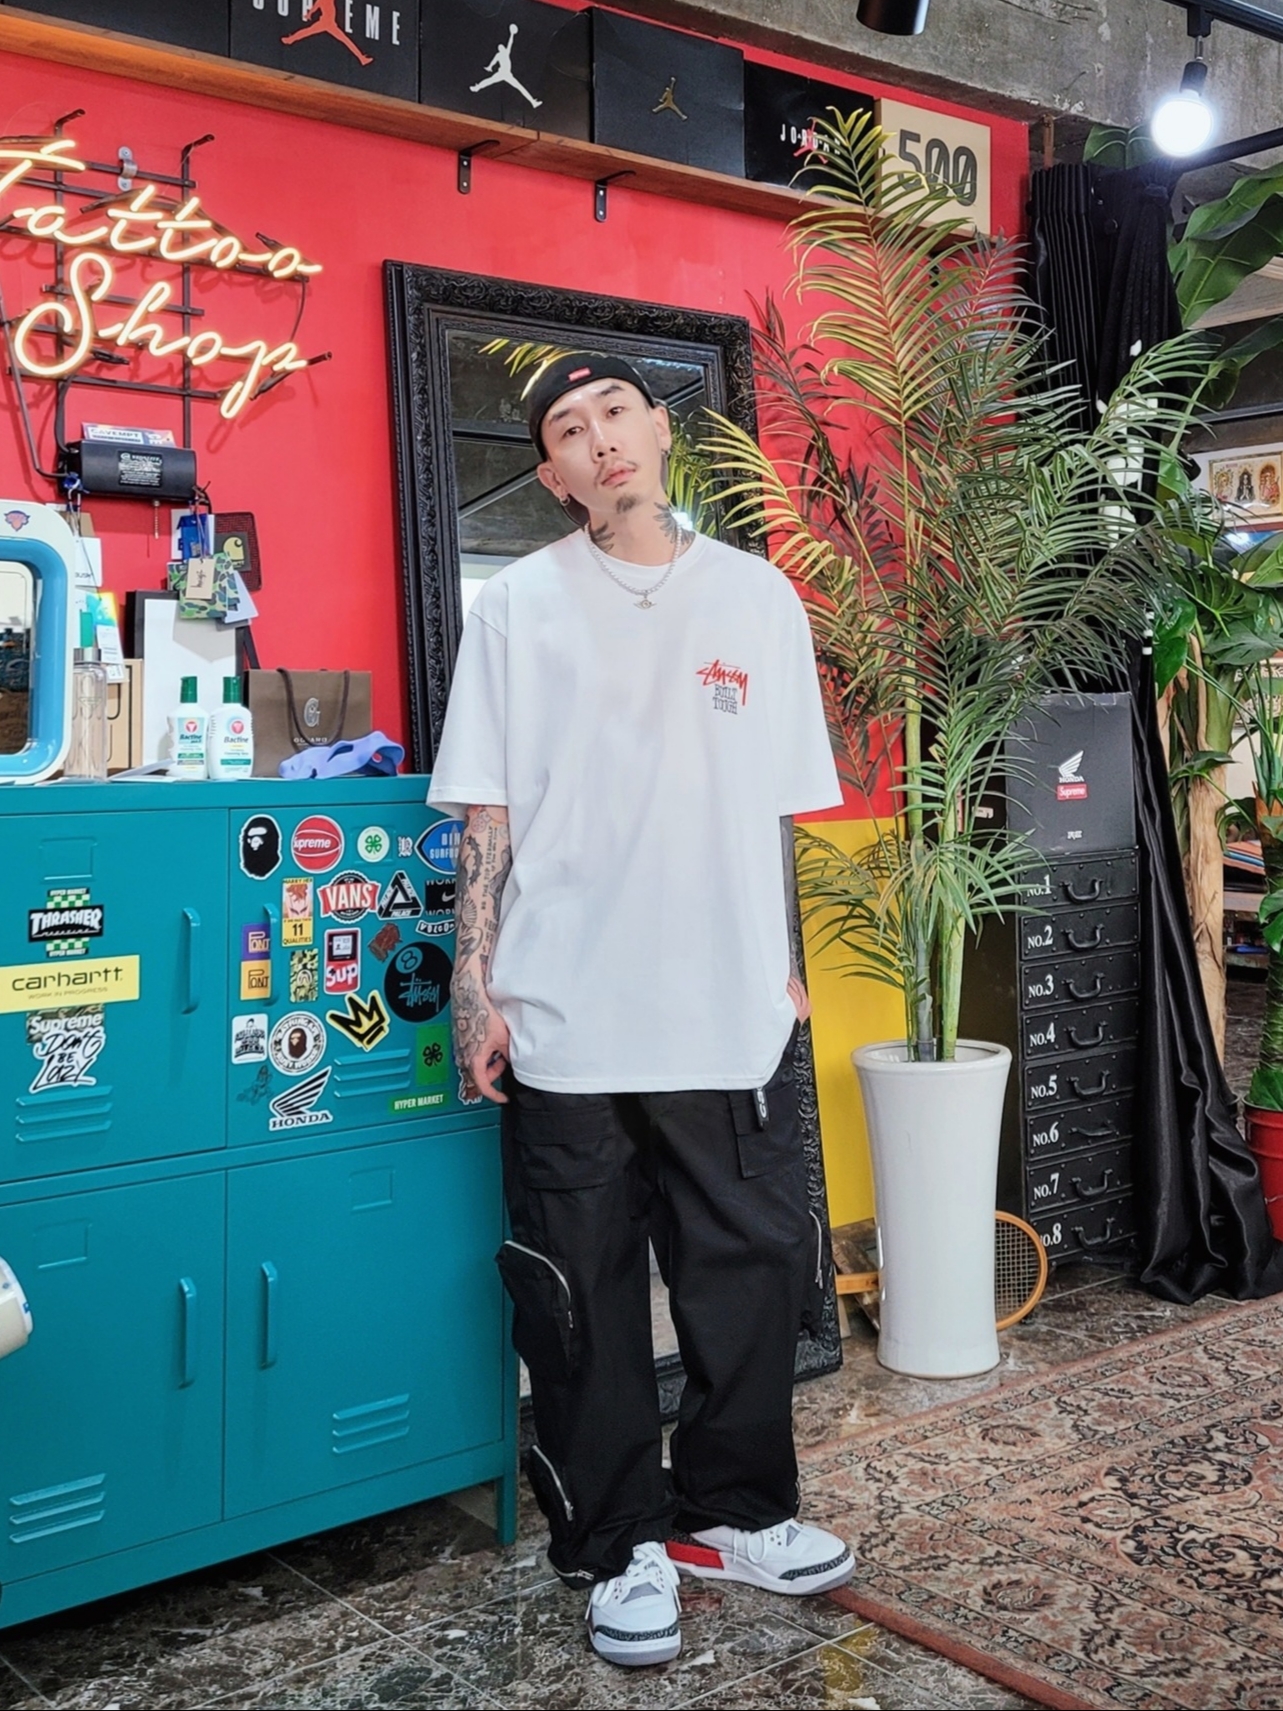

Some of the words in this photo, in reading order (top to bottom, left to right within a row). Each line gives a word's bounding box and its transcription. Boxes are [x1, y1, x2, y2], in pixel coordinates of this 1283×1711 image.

[897, 128, 977, 206] 500
[0, 139, 322, 278] Tattoo
[14, 252, 308, 420] Shop
[1060, 786, 1085, 798] Supreme
[294, 836, 331, 851] upreme
[326, 884, 372, 911] VANS
[30, 908, 103, 935] THRASHER
[292, 923, 304, 936] 11
[283, 937, 312, 946] QUALITIES
[1027, 925, 1054, 949] NO.2
[401, 951, 418, 970] 8
[12, 966, 123, 992] carhartt
[1028, 973, 1054, 998] NO.3
[28, 992, 52, 1000] WORK
[63, 987, 108, 996] PROGRESS
[29, 1012, 102, 1034] Supreme
[1029, 1022, 1056, 1047] NO.4
[57, 1052, 77, 1064] BE
[1031, 1074, 1058, 1099] NO.5
[394, 1098, 416, 1110] HYPER
[417, 1094, 444, 1106] MARKET
[272, 1112, 330, 1129] HONDA
[1032, 1121, 1059, 1147] NO.6
[1033, 1173, 1060, 1200] NO.7
[1041, 1223, 1062, 1247] O.8
